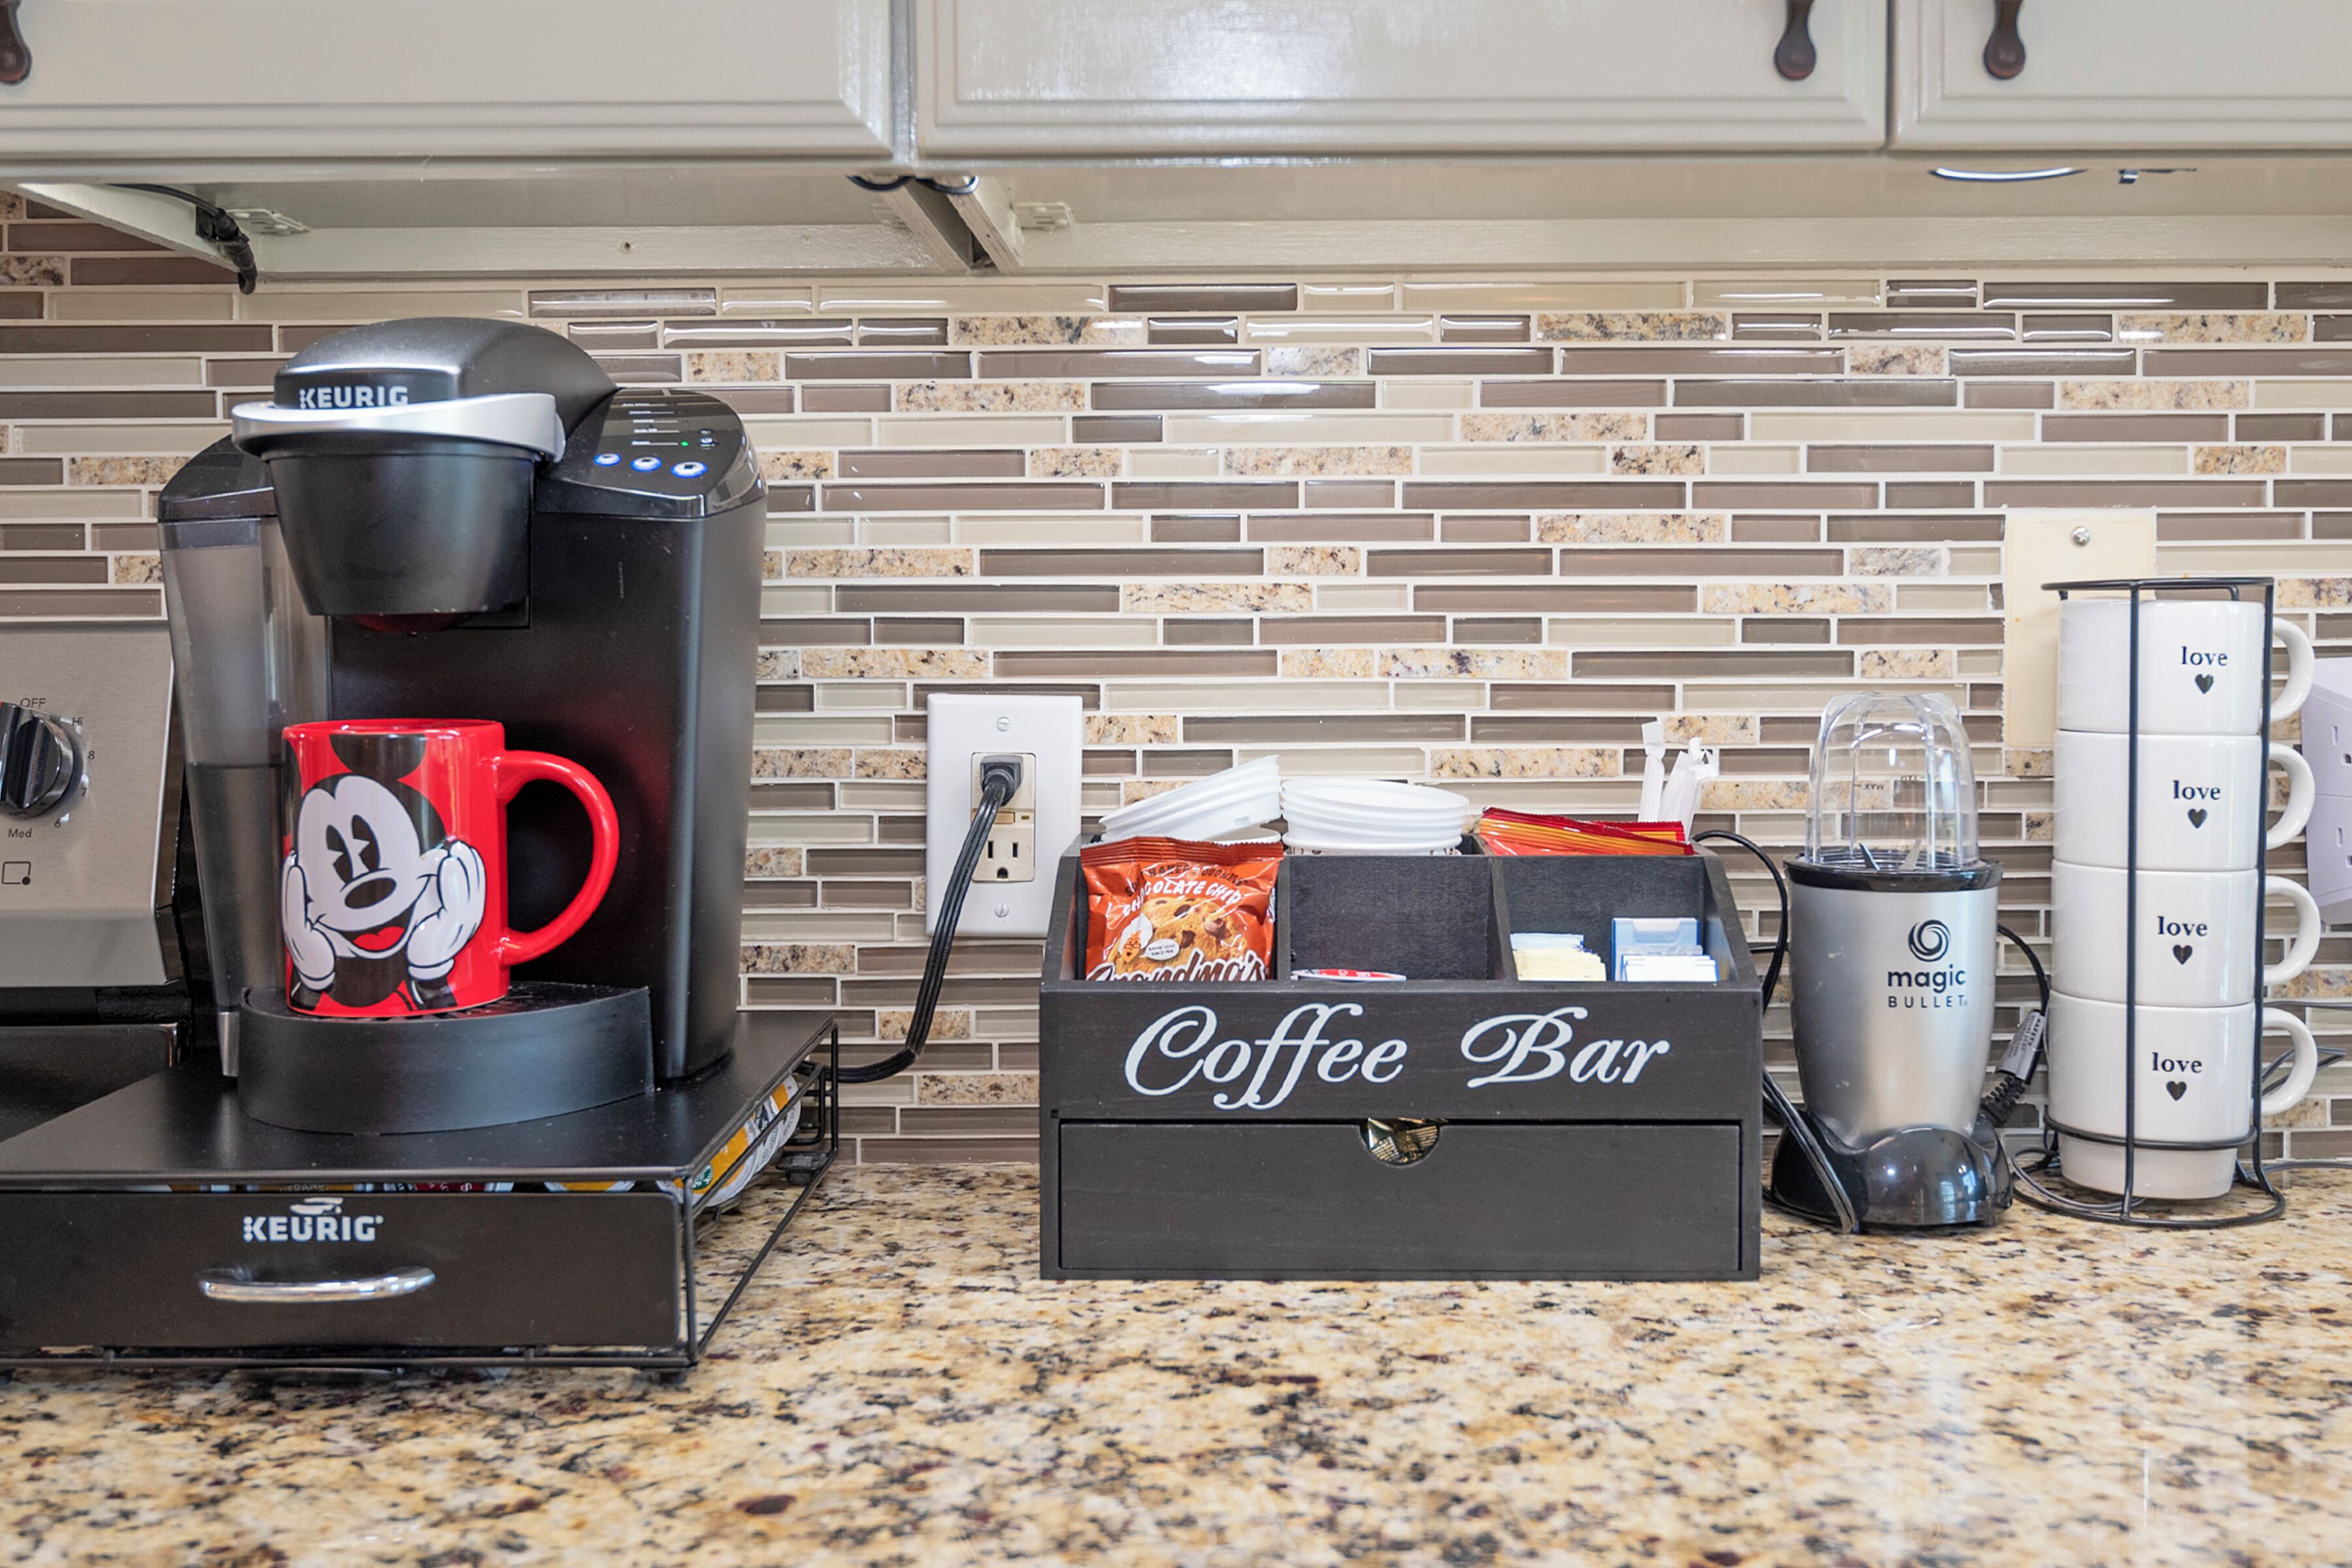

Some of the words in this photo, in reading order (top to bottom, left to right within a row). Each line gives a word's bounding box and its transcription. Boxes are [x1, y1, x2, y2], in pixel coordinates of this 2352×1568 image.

[300, 385, 408, 410] KEURIG
[2180, 646, 2228, 666] love
[20, 698, 46, 708] OFF
[72, 717, 83, 727] Hi
[88, 751, 95, 760] 8
[81, 788, 88, 797] 7
[2172, 780, 2221, 800] love
[8, 828, 33, 838] Med
[54, 819, 61, 828] 6
[1205, 883, 1241, 905] CHIP
[2157, 916, 2208, 936] love
[1887, 964, 1966, 994] magic
[1887, 995, 1965, 1008] BULLET
[1124, 1003, 1408, 1110] Coffee
[1461, 1006, 1671, 1088] Bar
[2151, 1053, 2203, 1073] love
[242, 1216, 376, 1243] KEURIG
